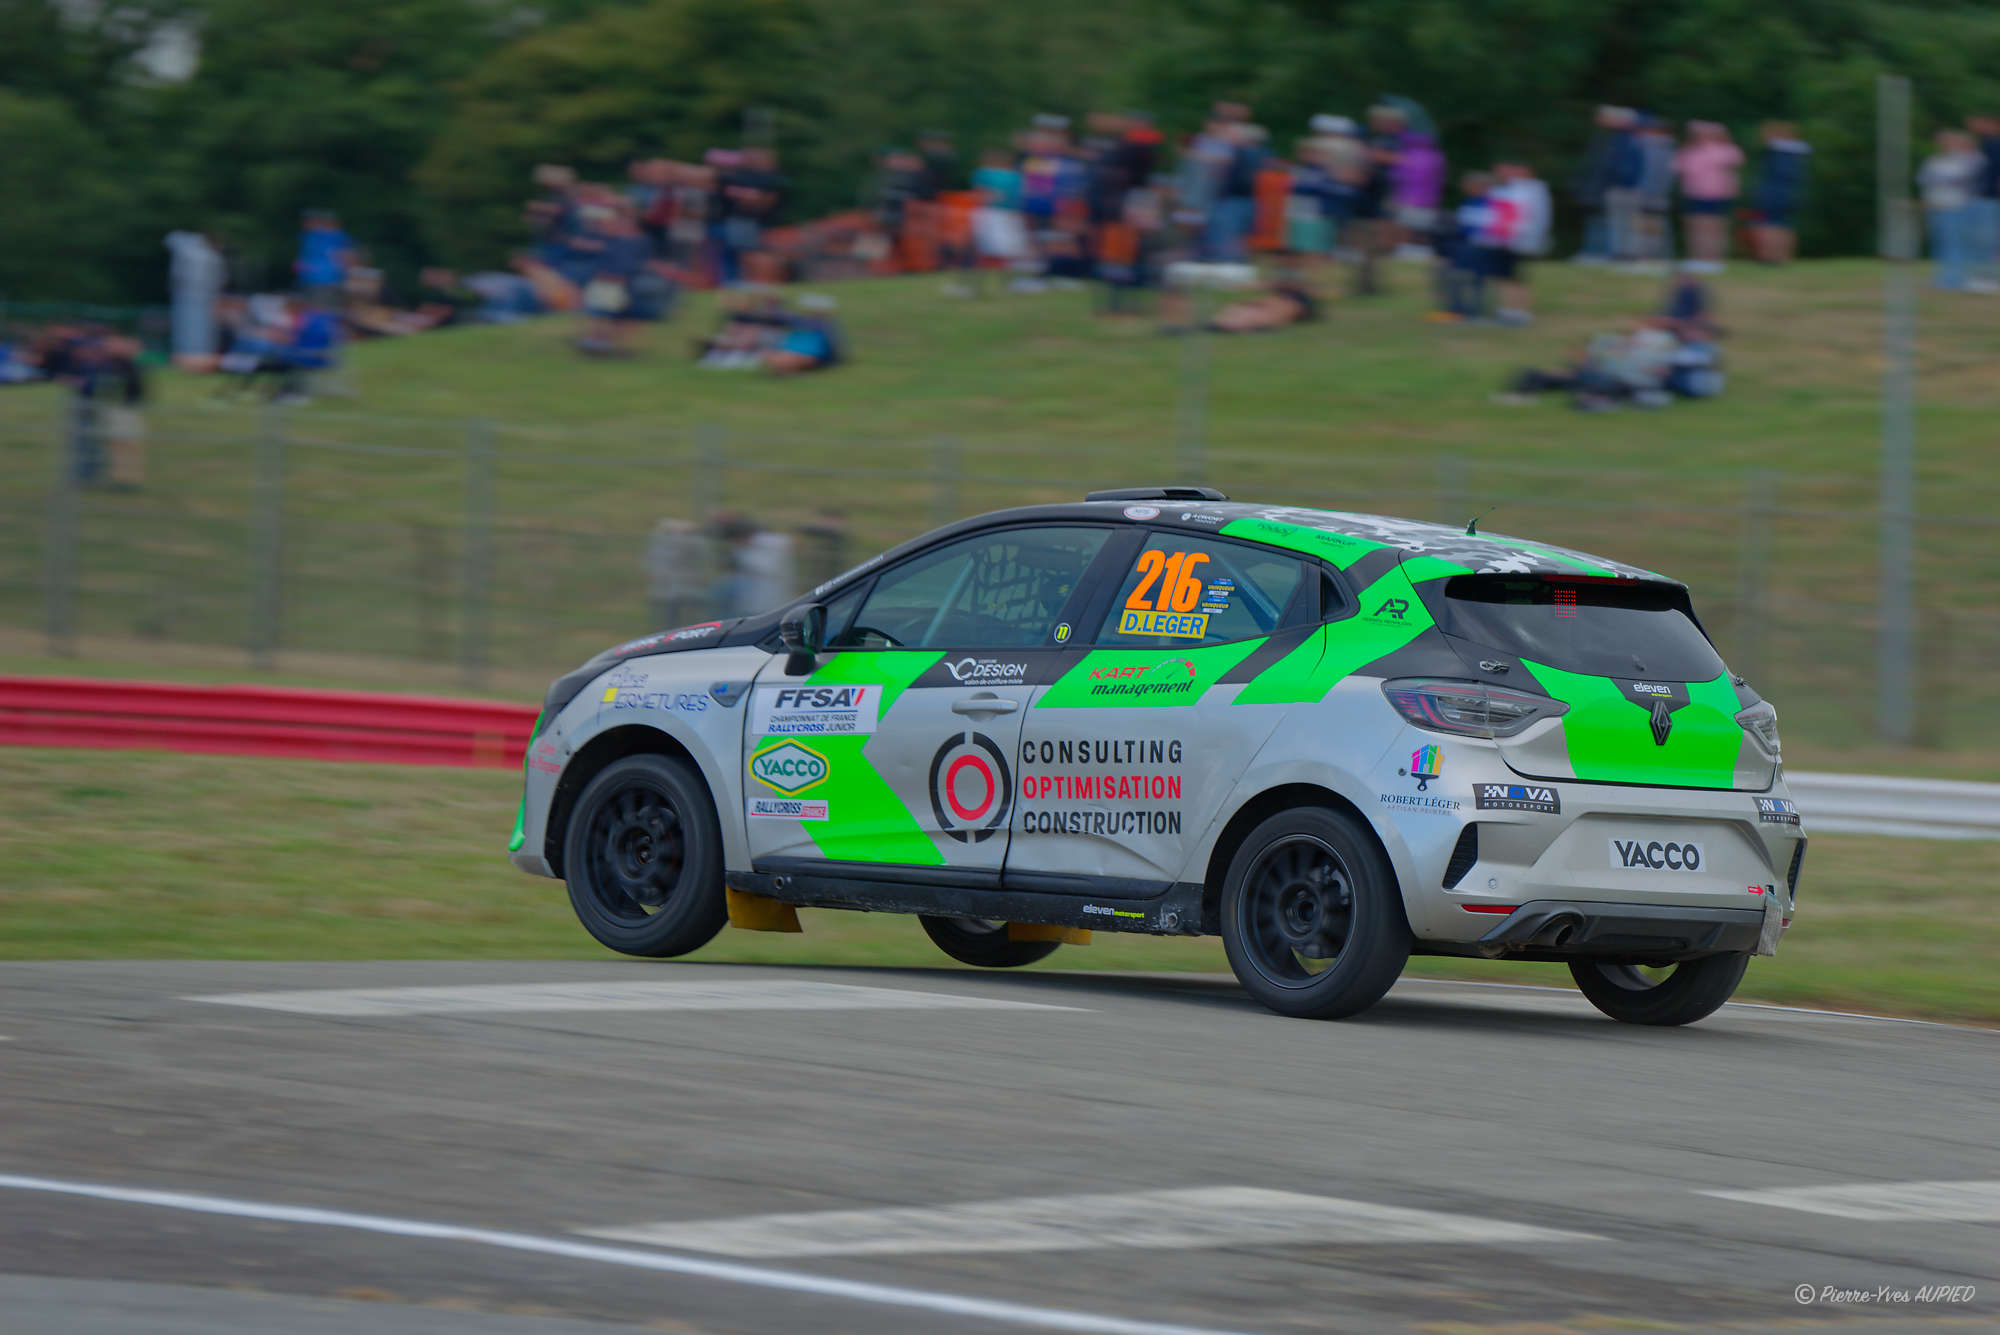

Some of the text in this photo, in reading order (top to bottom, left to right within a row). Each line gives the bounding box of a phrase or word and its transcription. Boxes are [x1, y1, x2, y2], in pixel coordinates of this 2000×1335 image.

[1125, 549, 1211, 613] 216
[1124, 613, 1205, 636] D.LEGER
[1088, 666, 1152, 680] KART
[1091, 679, 1195, 699] management
[1633, 682, 1671, 694] eleven
[775, 688, 851, 708] FFSA
[831, 713, 857, 721] FRANCE
[768, 722, 856, 733] RALLYCROSS JUNIOR
[1023, 740, 1183, 764] CONSULTING
[760, 758, 821, 777] YACCO
[1023, 776, 1182, 799] OPTIMISATION
[1484, 784, 1554, 802] NOVA
[756, 801, 802, 814] RALLYCROSS
[1380, 793, 1461, 810] ROBERT LÉGER
[1484, 802, 1555, 812] MOTORSPORT
[1024, 811, 1182, 835] CONSTRUCTION
[1614, 840, 1700, 870] YACCO
[1083, 904, 1115, 916] eleven
